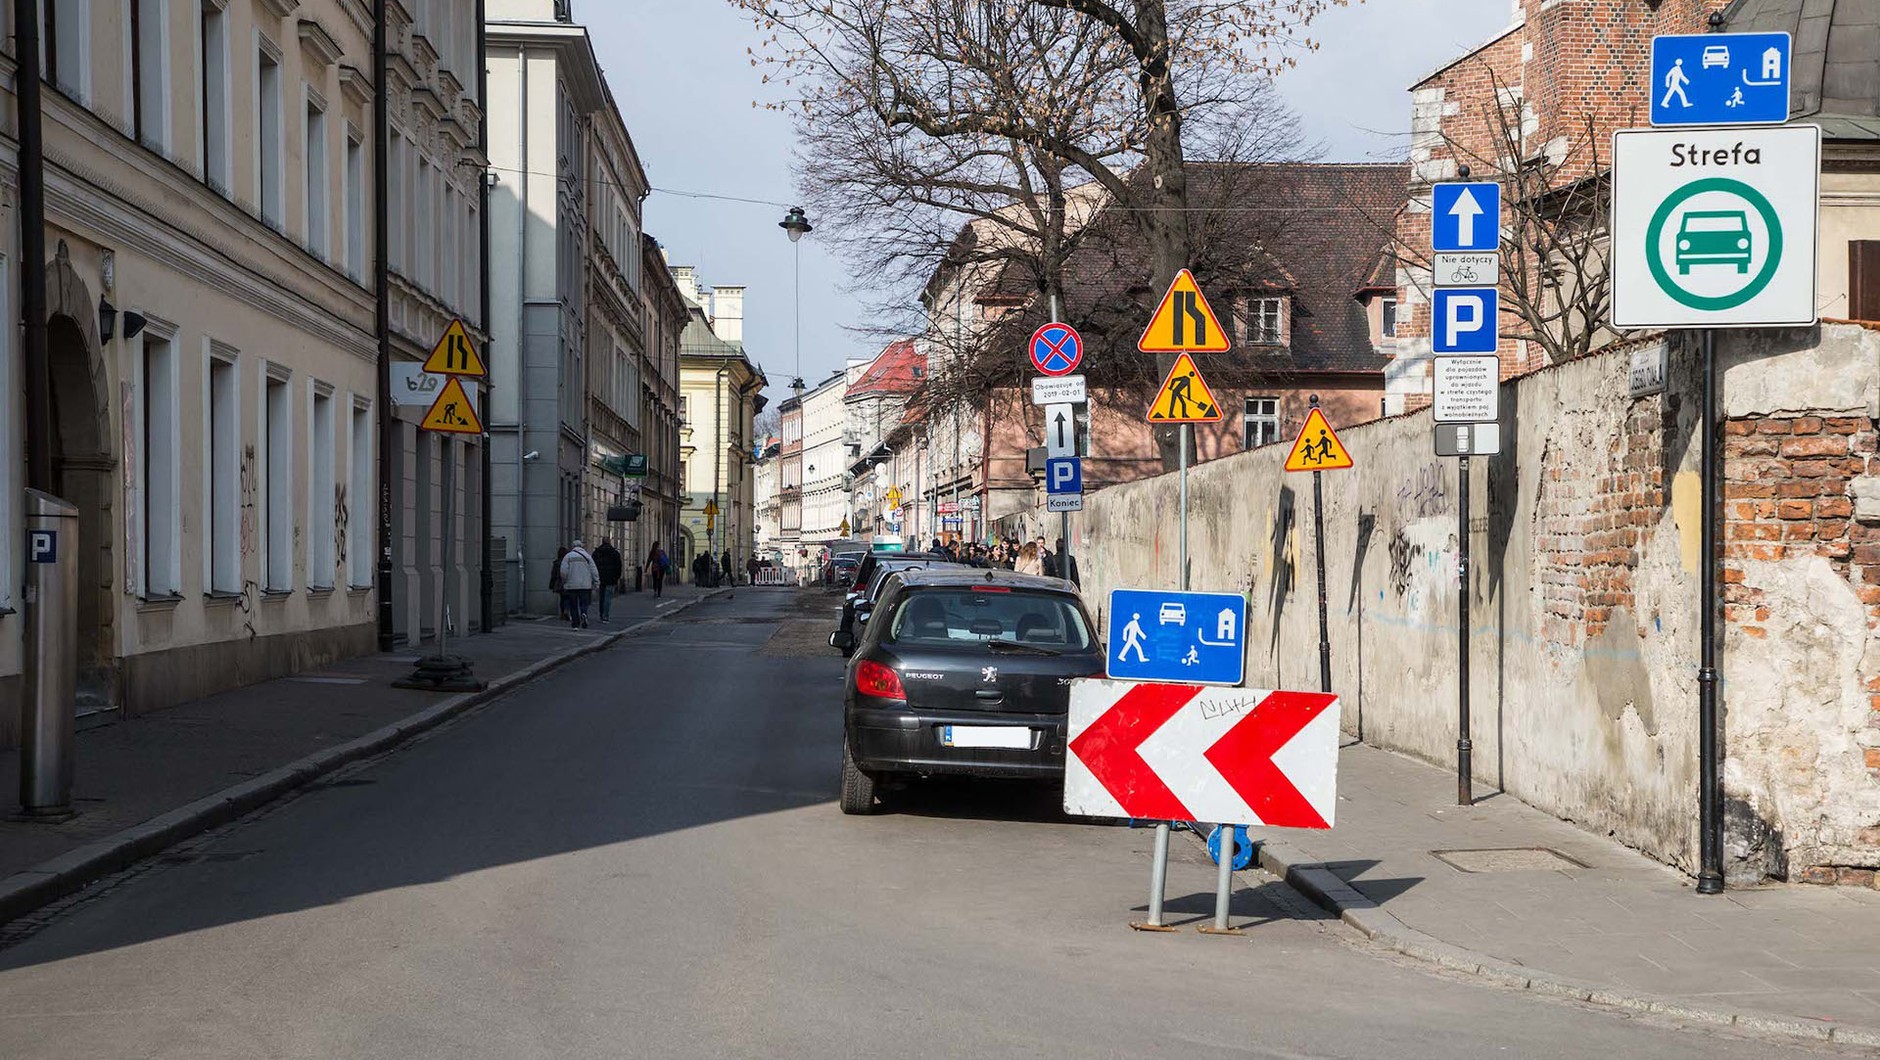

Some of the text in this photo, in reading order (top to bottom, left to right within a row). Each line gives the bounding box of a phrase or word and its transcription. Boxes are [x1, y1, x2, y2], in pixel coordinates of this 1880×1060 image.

[1670, 142, 1761, 167] Strefa
[1461, 256, 1493, 265] dotyczy
[1446, 295, 1484, 347] P
[1053, 462, 1074, 490] P
[1050, 498, 1080, 508] Koniec
[31, 533, 51, 561] P
[905, 672, 944, 680] PEUGEOT
[1056, 677, 1072, 686] 30
